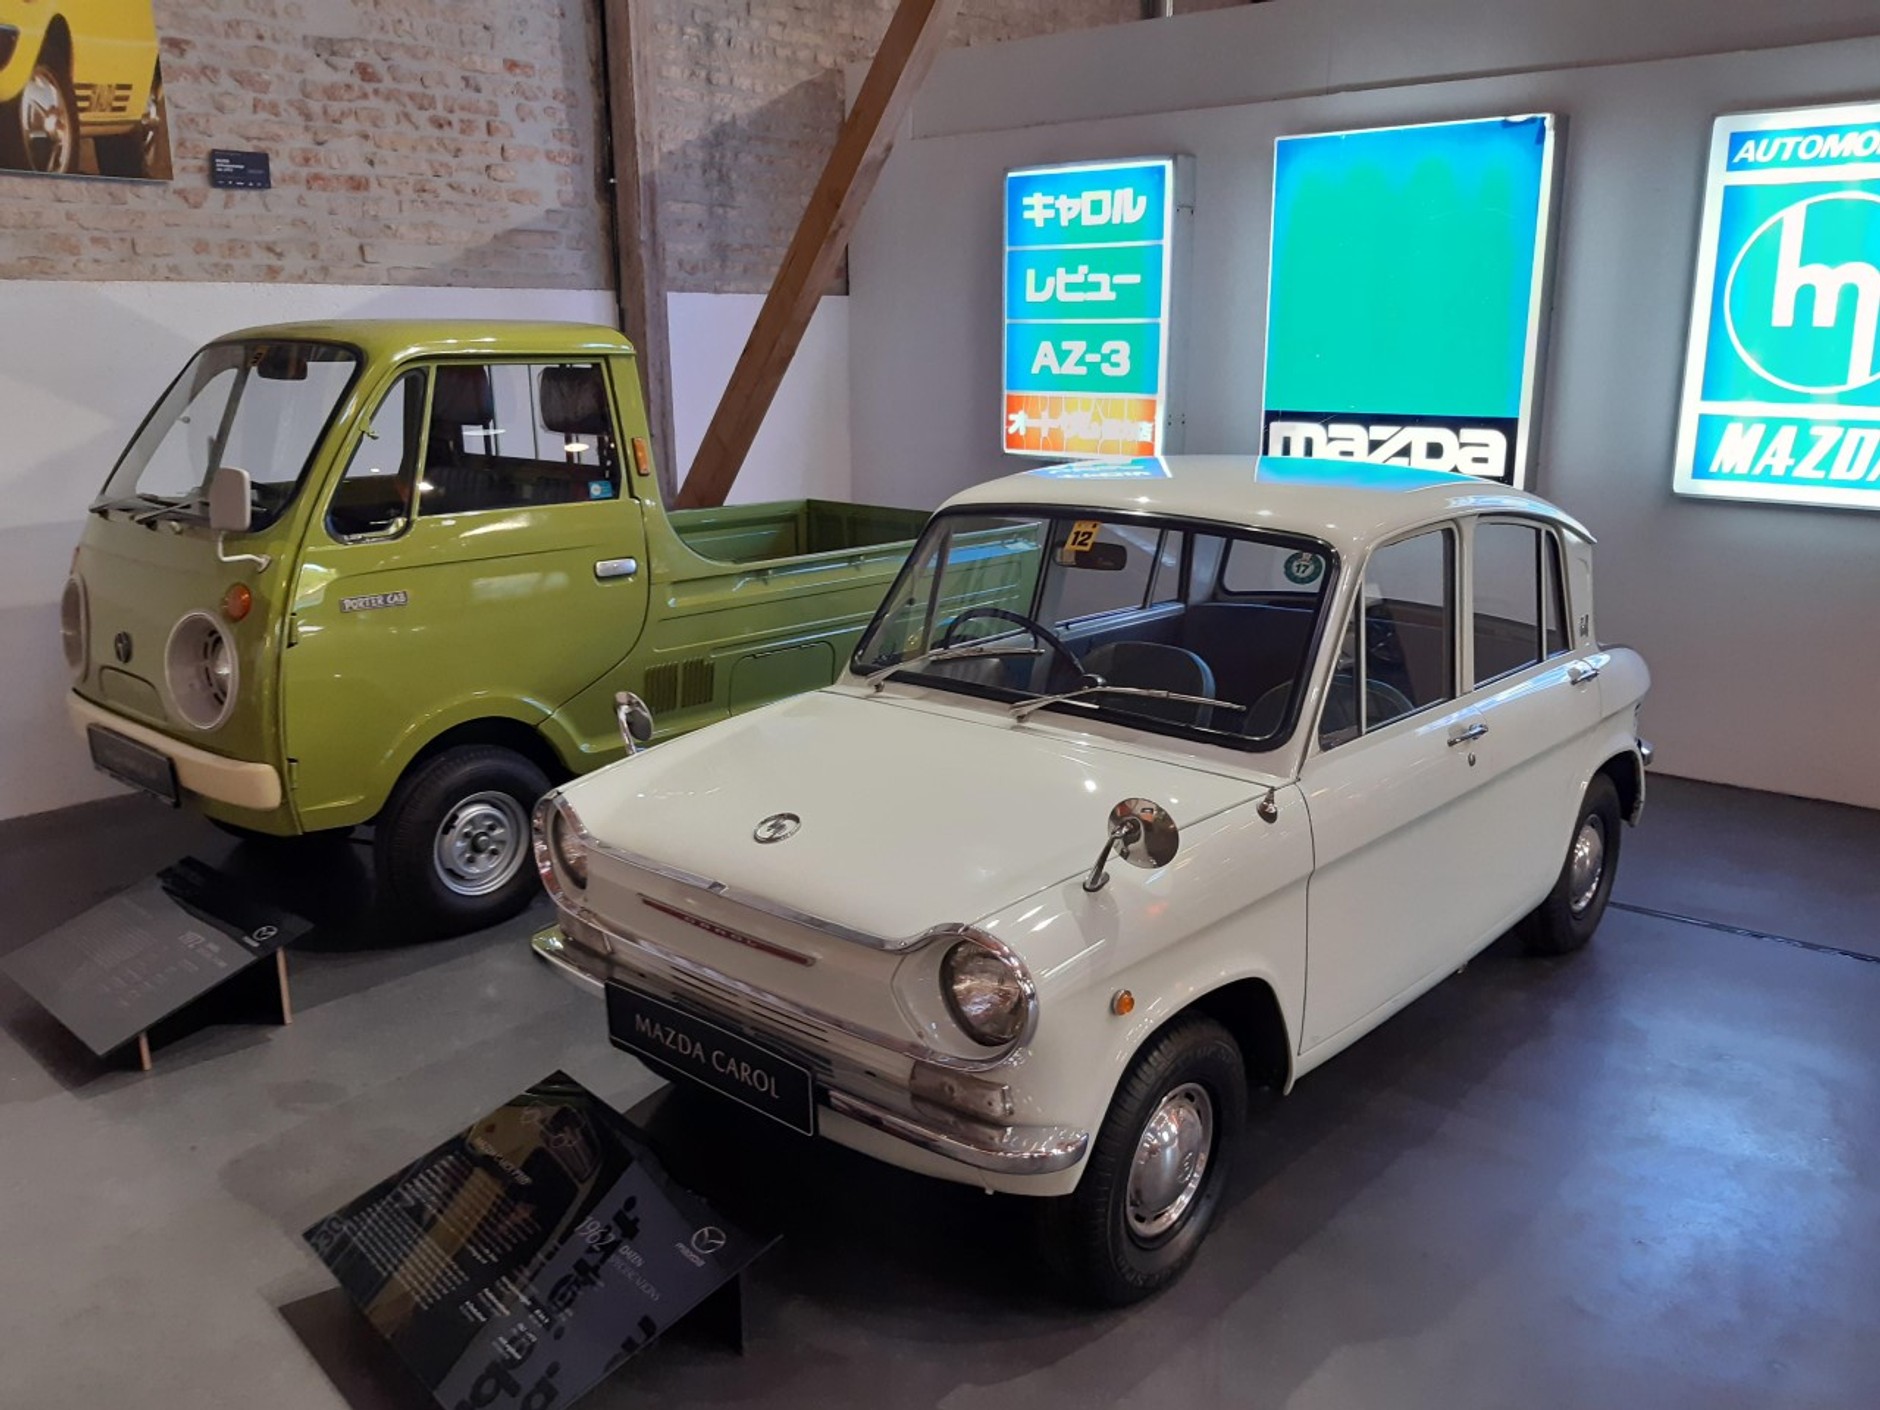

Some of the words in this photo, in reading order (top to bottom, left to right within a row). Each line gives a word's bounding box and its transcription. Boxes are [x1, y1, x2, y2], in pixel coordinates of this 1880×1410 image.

[1733, 129, 1880, 163] AUTOMO
[1022, 187, 1147, 228] キャロル
[1025, 264, 1141, 303] レビュー
[1031, 340, 1131, 376] AZ-3
[1070, 530, 1093, 546] 12
[1295, 563, 1310, 575] 17
[343, 595, 385, 611] PORTER
[386, 592, 407, 605] CAB
[635, 1013, 706, 1064] MAZDA
[711, 1050, 780, 1100] CAROL
[574, 1216, 617, 1252] 1962
